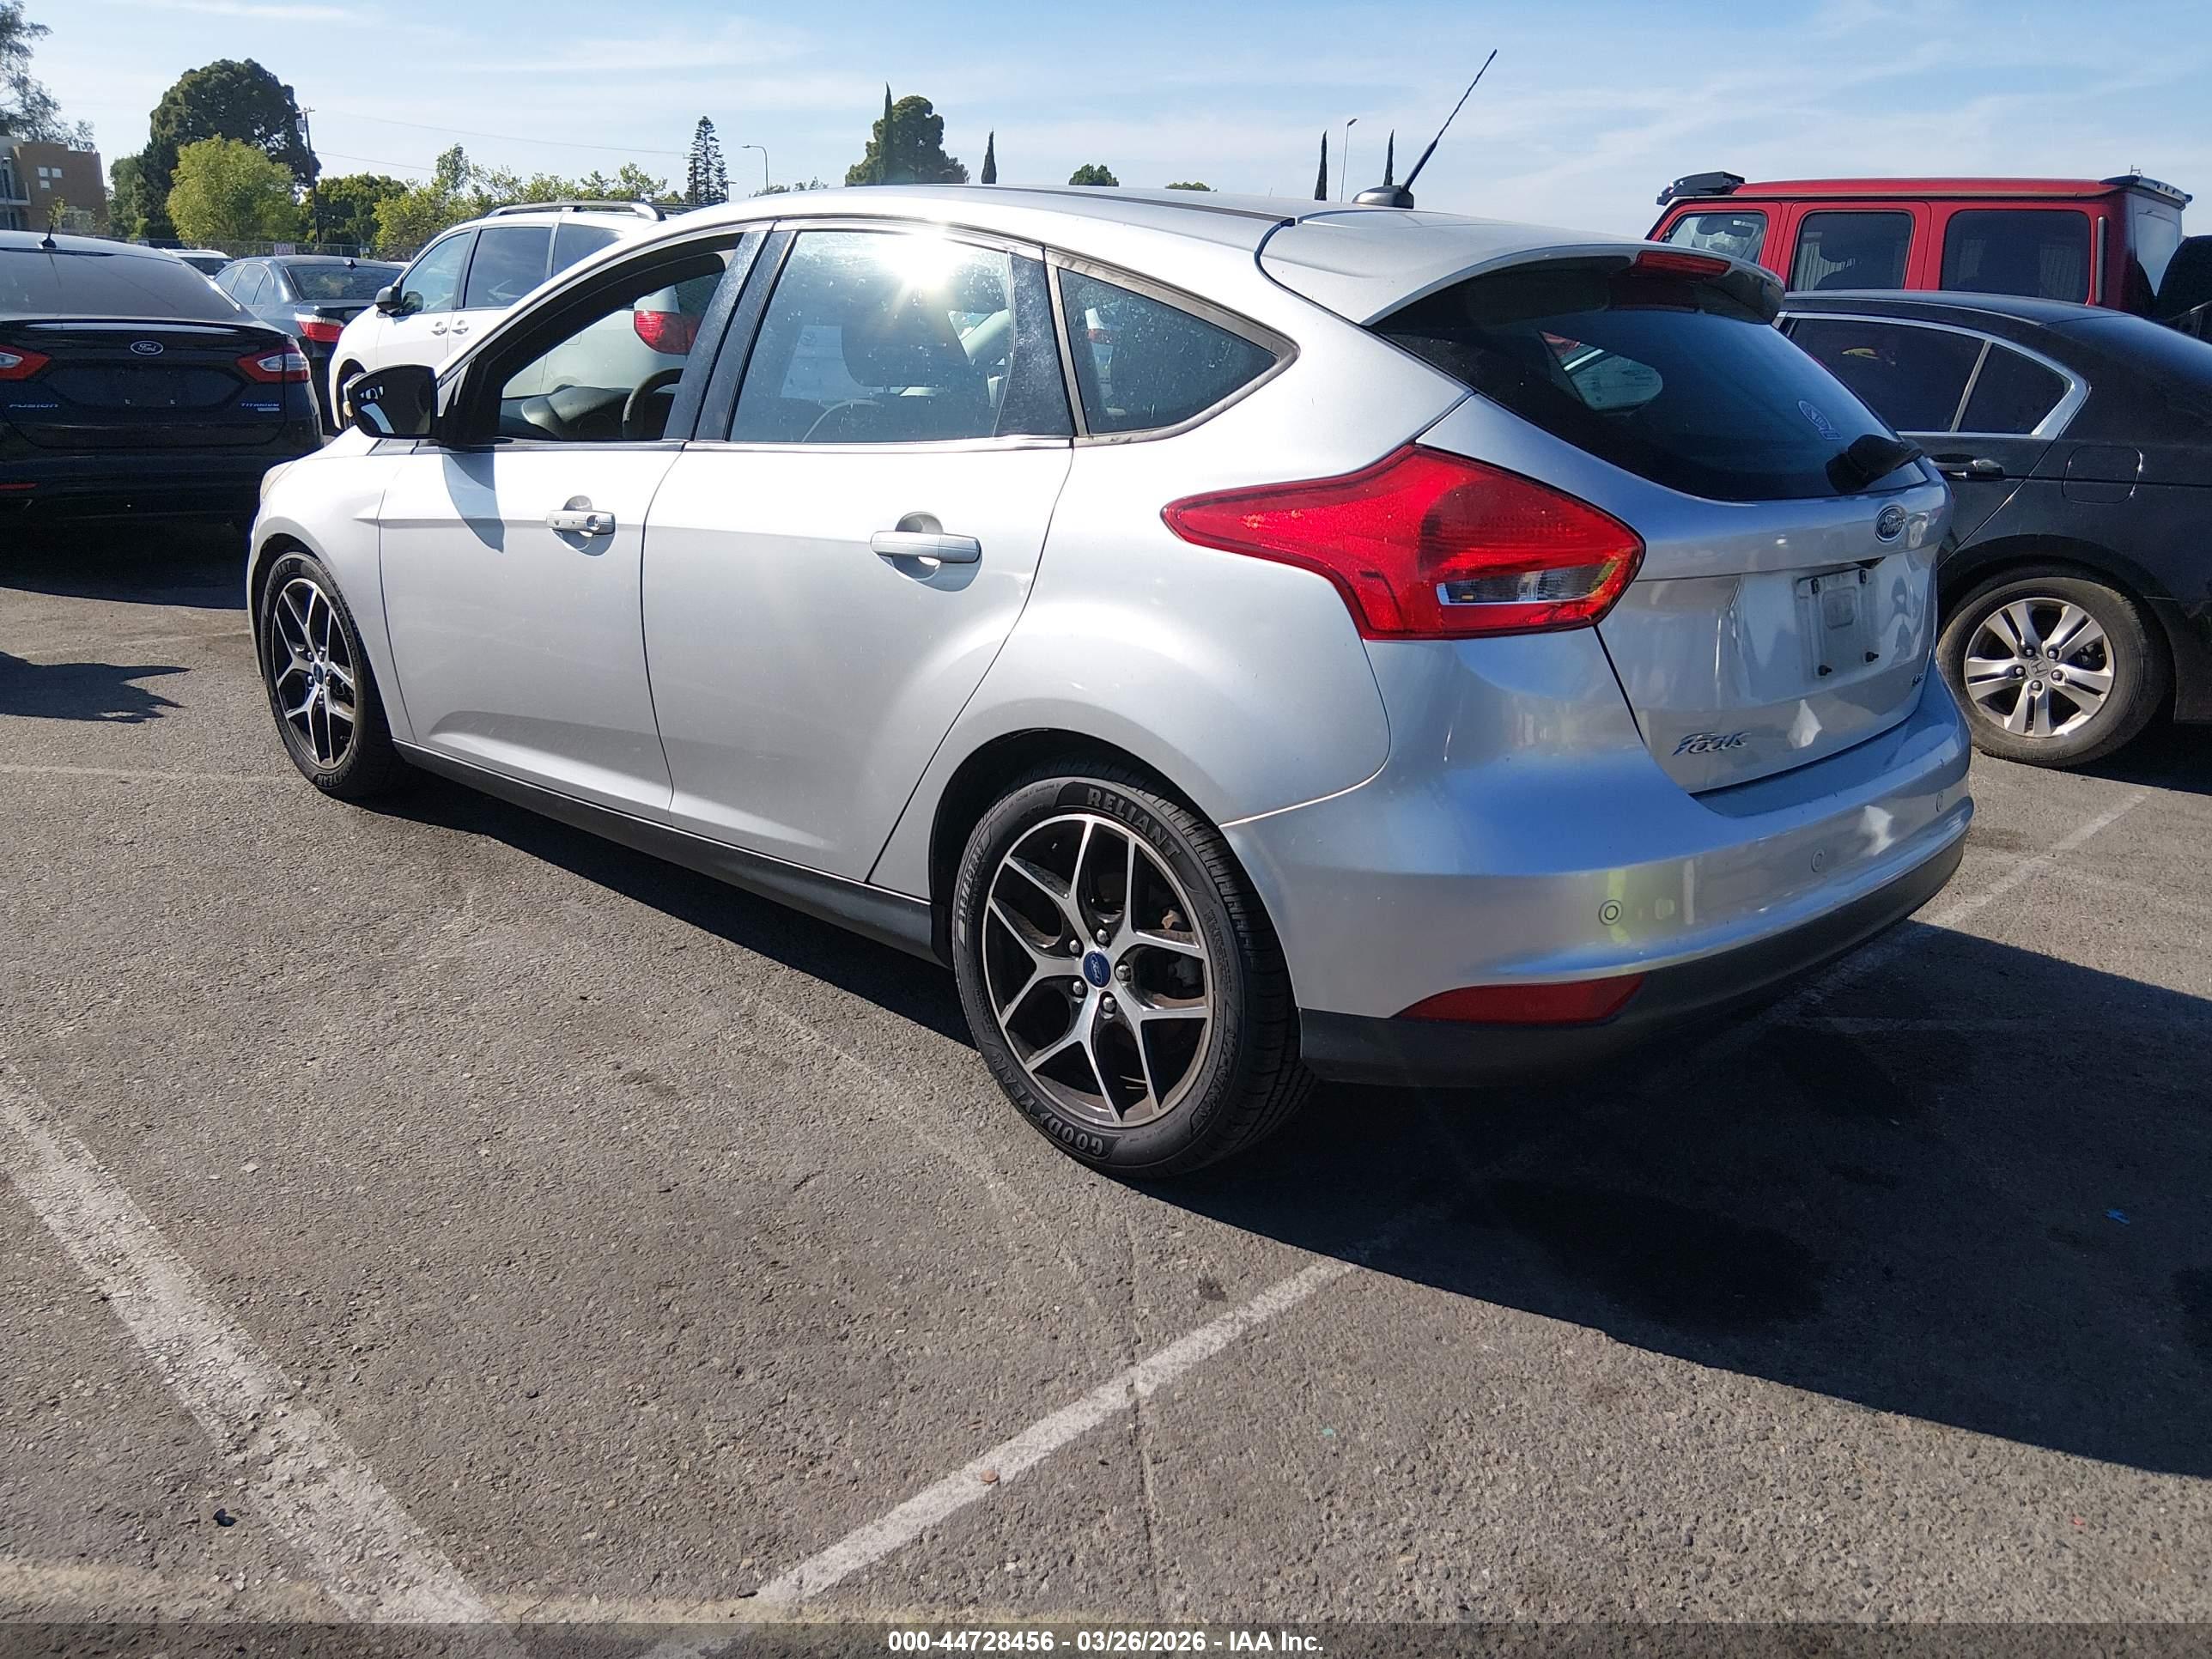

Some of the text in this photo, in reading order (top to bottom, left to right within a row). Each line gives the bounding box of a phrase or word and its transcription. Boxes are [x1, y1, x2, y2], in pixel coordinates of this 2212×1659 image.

[1672, 731, 1752, 757] Focus
[1086, 787, 1182, 860] RELIANT
[991, 1052, 1103, 1155] GOODYEAR
